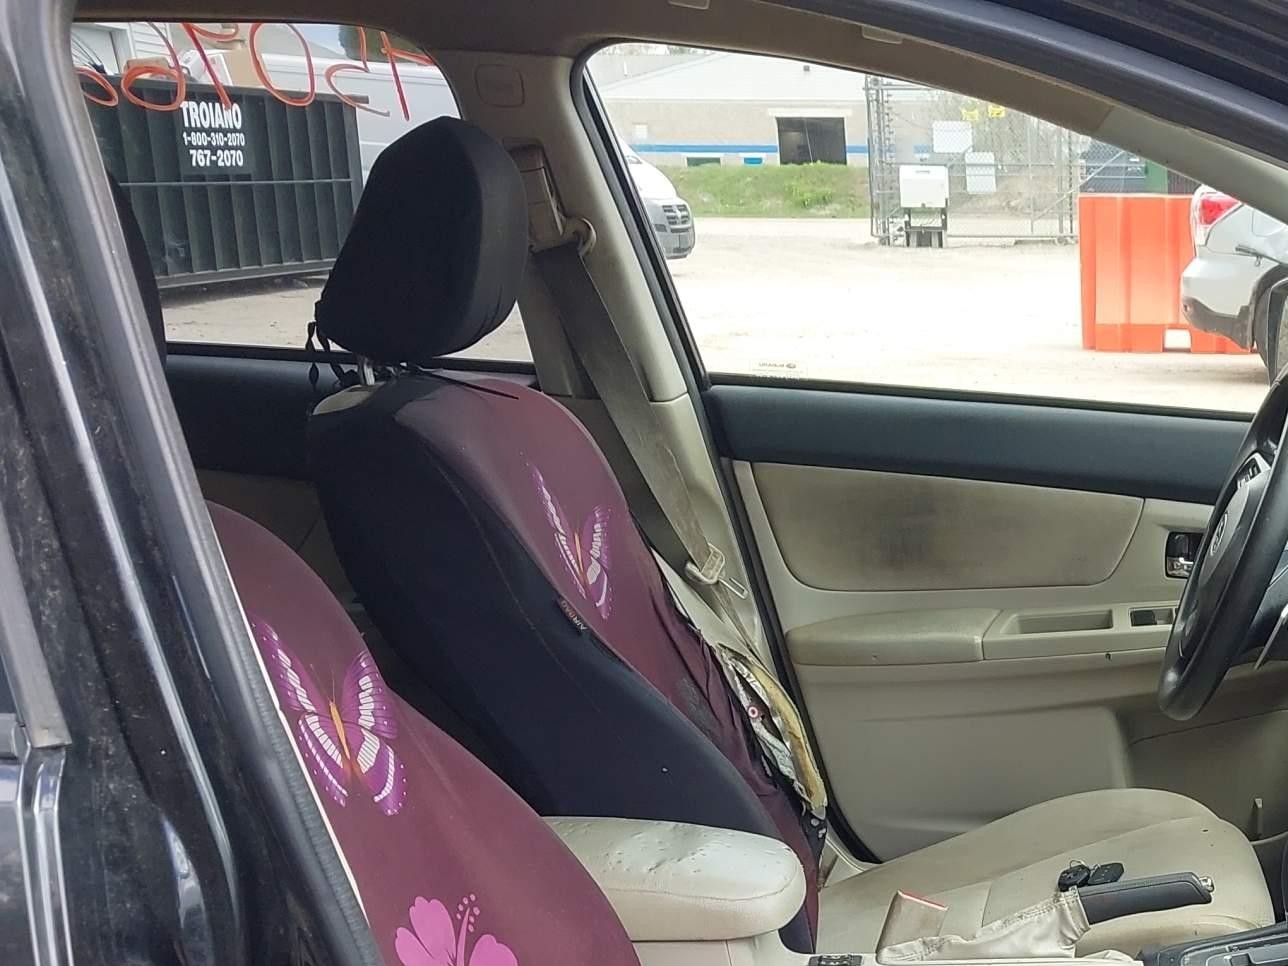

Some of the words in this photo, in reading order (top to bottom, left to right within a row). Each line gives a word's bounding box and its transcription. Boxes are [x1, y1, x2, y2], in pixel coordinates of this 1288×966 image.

[180, 101, 242, 129] TROIANO
[182, 131, 245, 147] 1-800-310-2070
[189, 149, 244, 167] 767-2070
